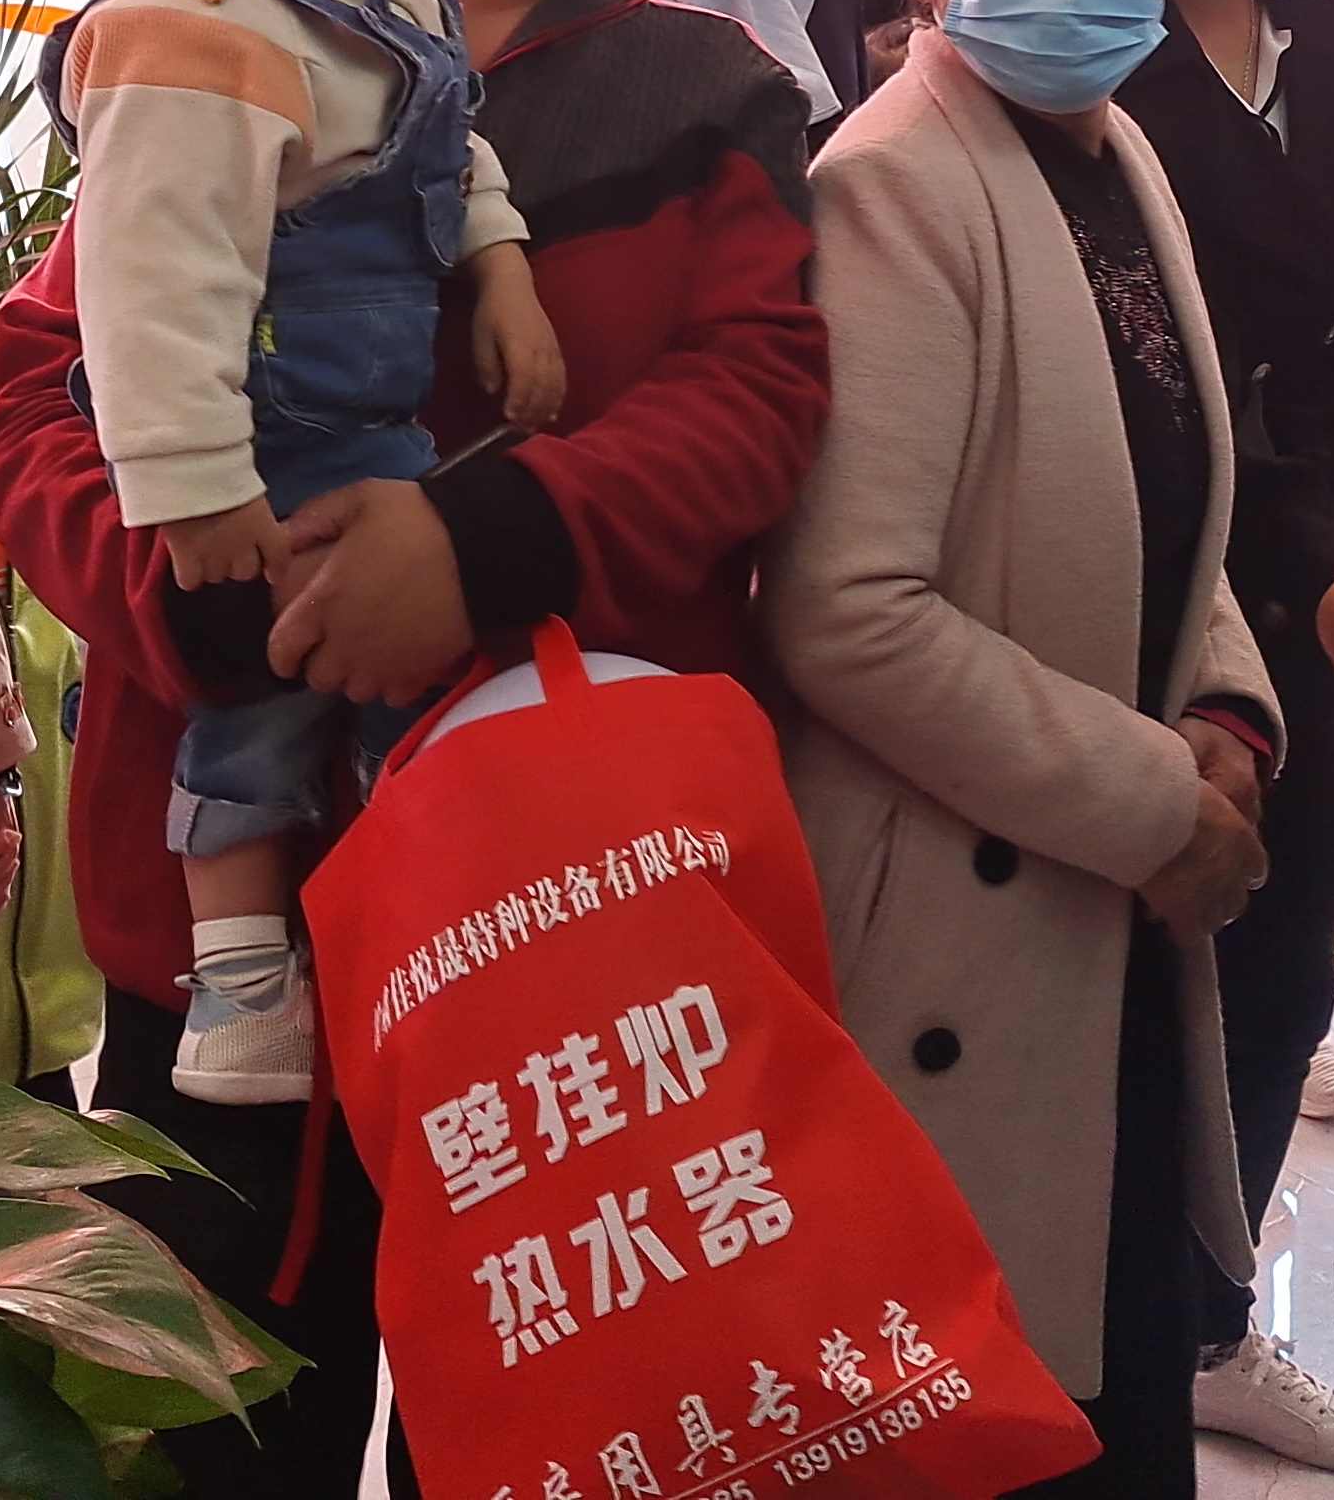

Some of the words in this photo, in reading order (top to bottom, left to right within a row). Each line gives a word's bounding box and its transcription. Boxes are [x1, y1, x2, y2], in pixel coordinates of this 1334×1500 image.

[420, 983, 728, 1214] 壁挂炉
[472, 1128, 794, 1368] 热水器
[773, 1368, 971, 1487] 13919138135
